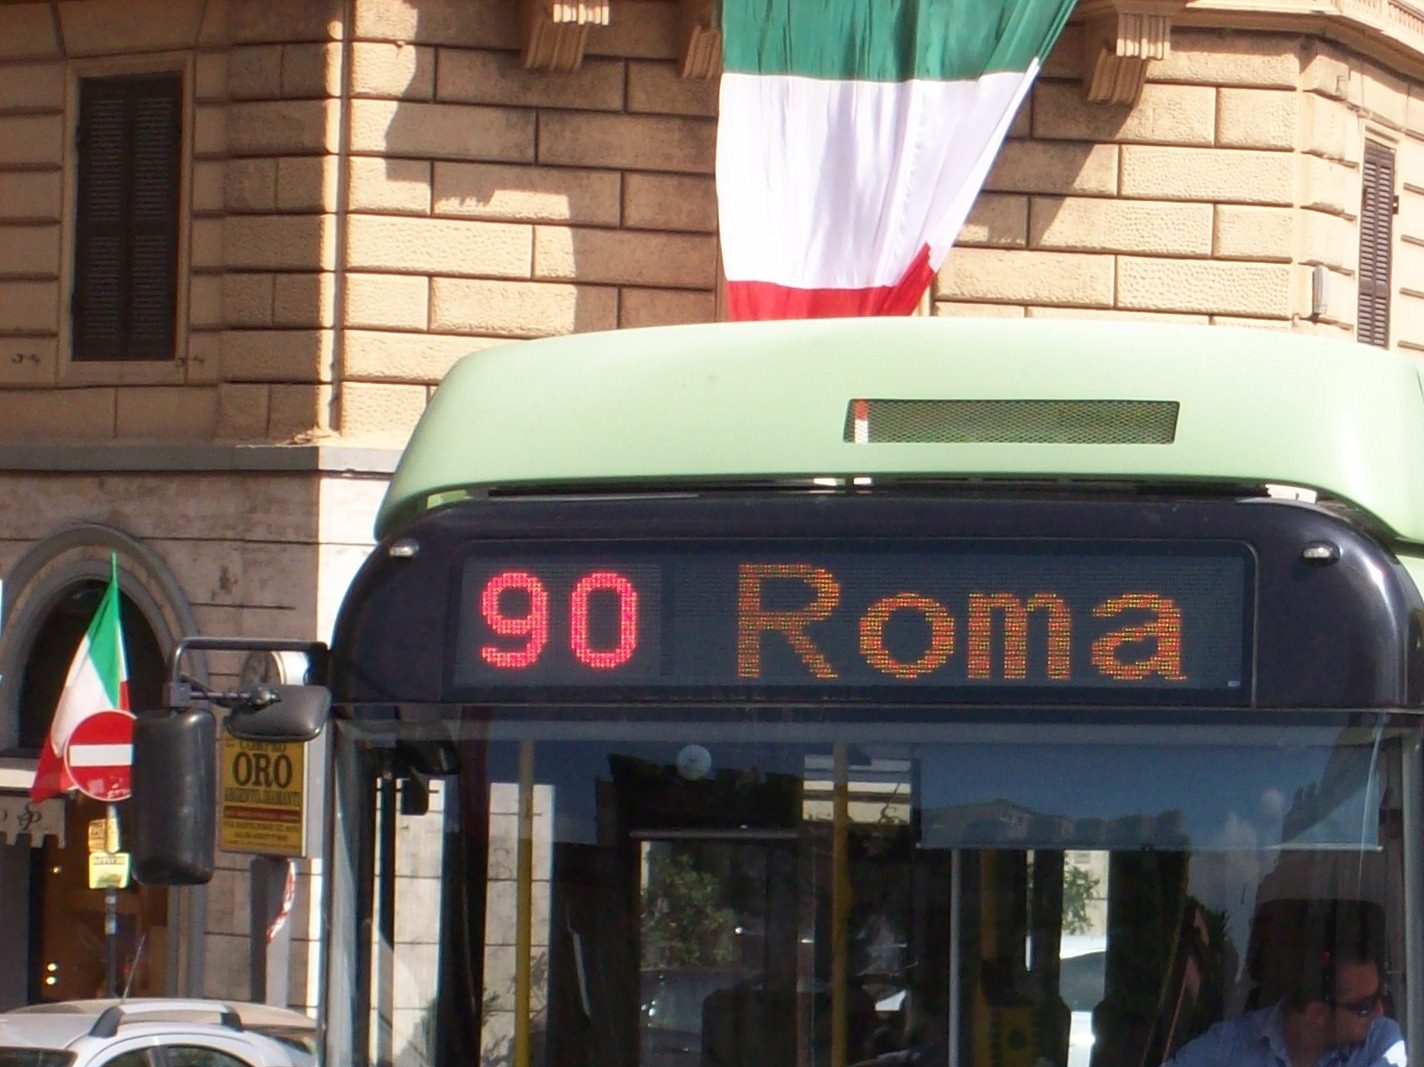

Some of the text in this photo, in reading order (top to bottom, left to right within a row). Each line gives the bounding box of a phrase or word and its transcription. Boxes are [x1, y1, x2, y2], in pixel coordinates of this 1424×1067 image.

[481, 571, 639, 669] 90
[736, 562, 1188, 681] Roma
[232, 750, 293, 789] ORO
